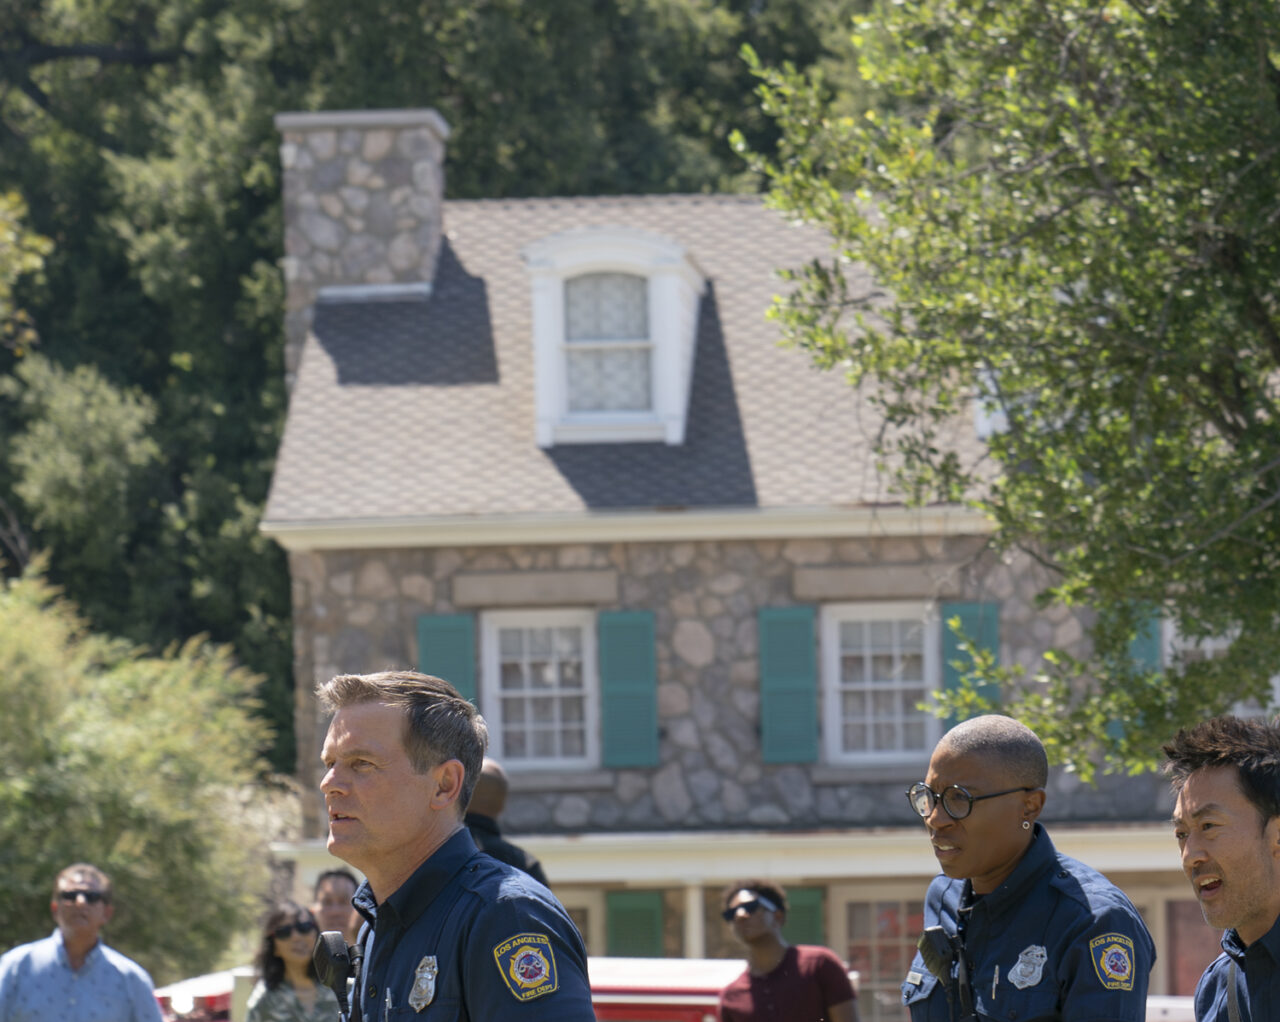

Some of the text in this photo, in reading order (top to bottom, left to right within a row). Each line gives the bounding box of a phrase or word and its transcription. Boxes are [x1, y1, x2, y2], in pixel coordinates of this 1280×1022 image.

[497, 936, 548, 957] LOS ANGELES
[521, 989, 536, 999] FIRE
